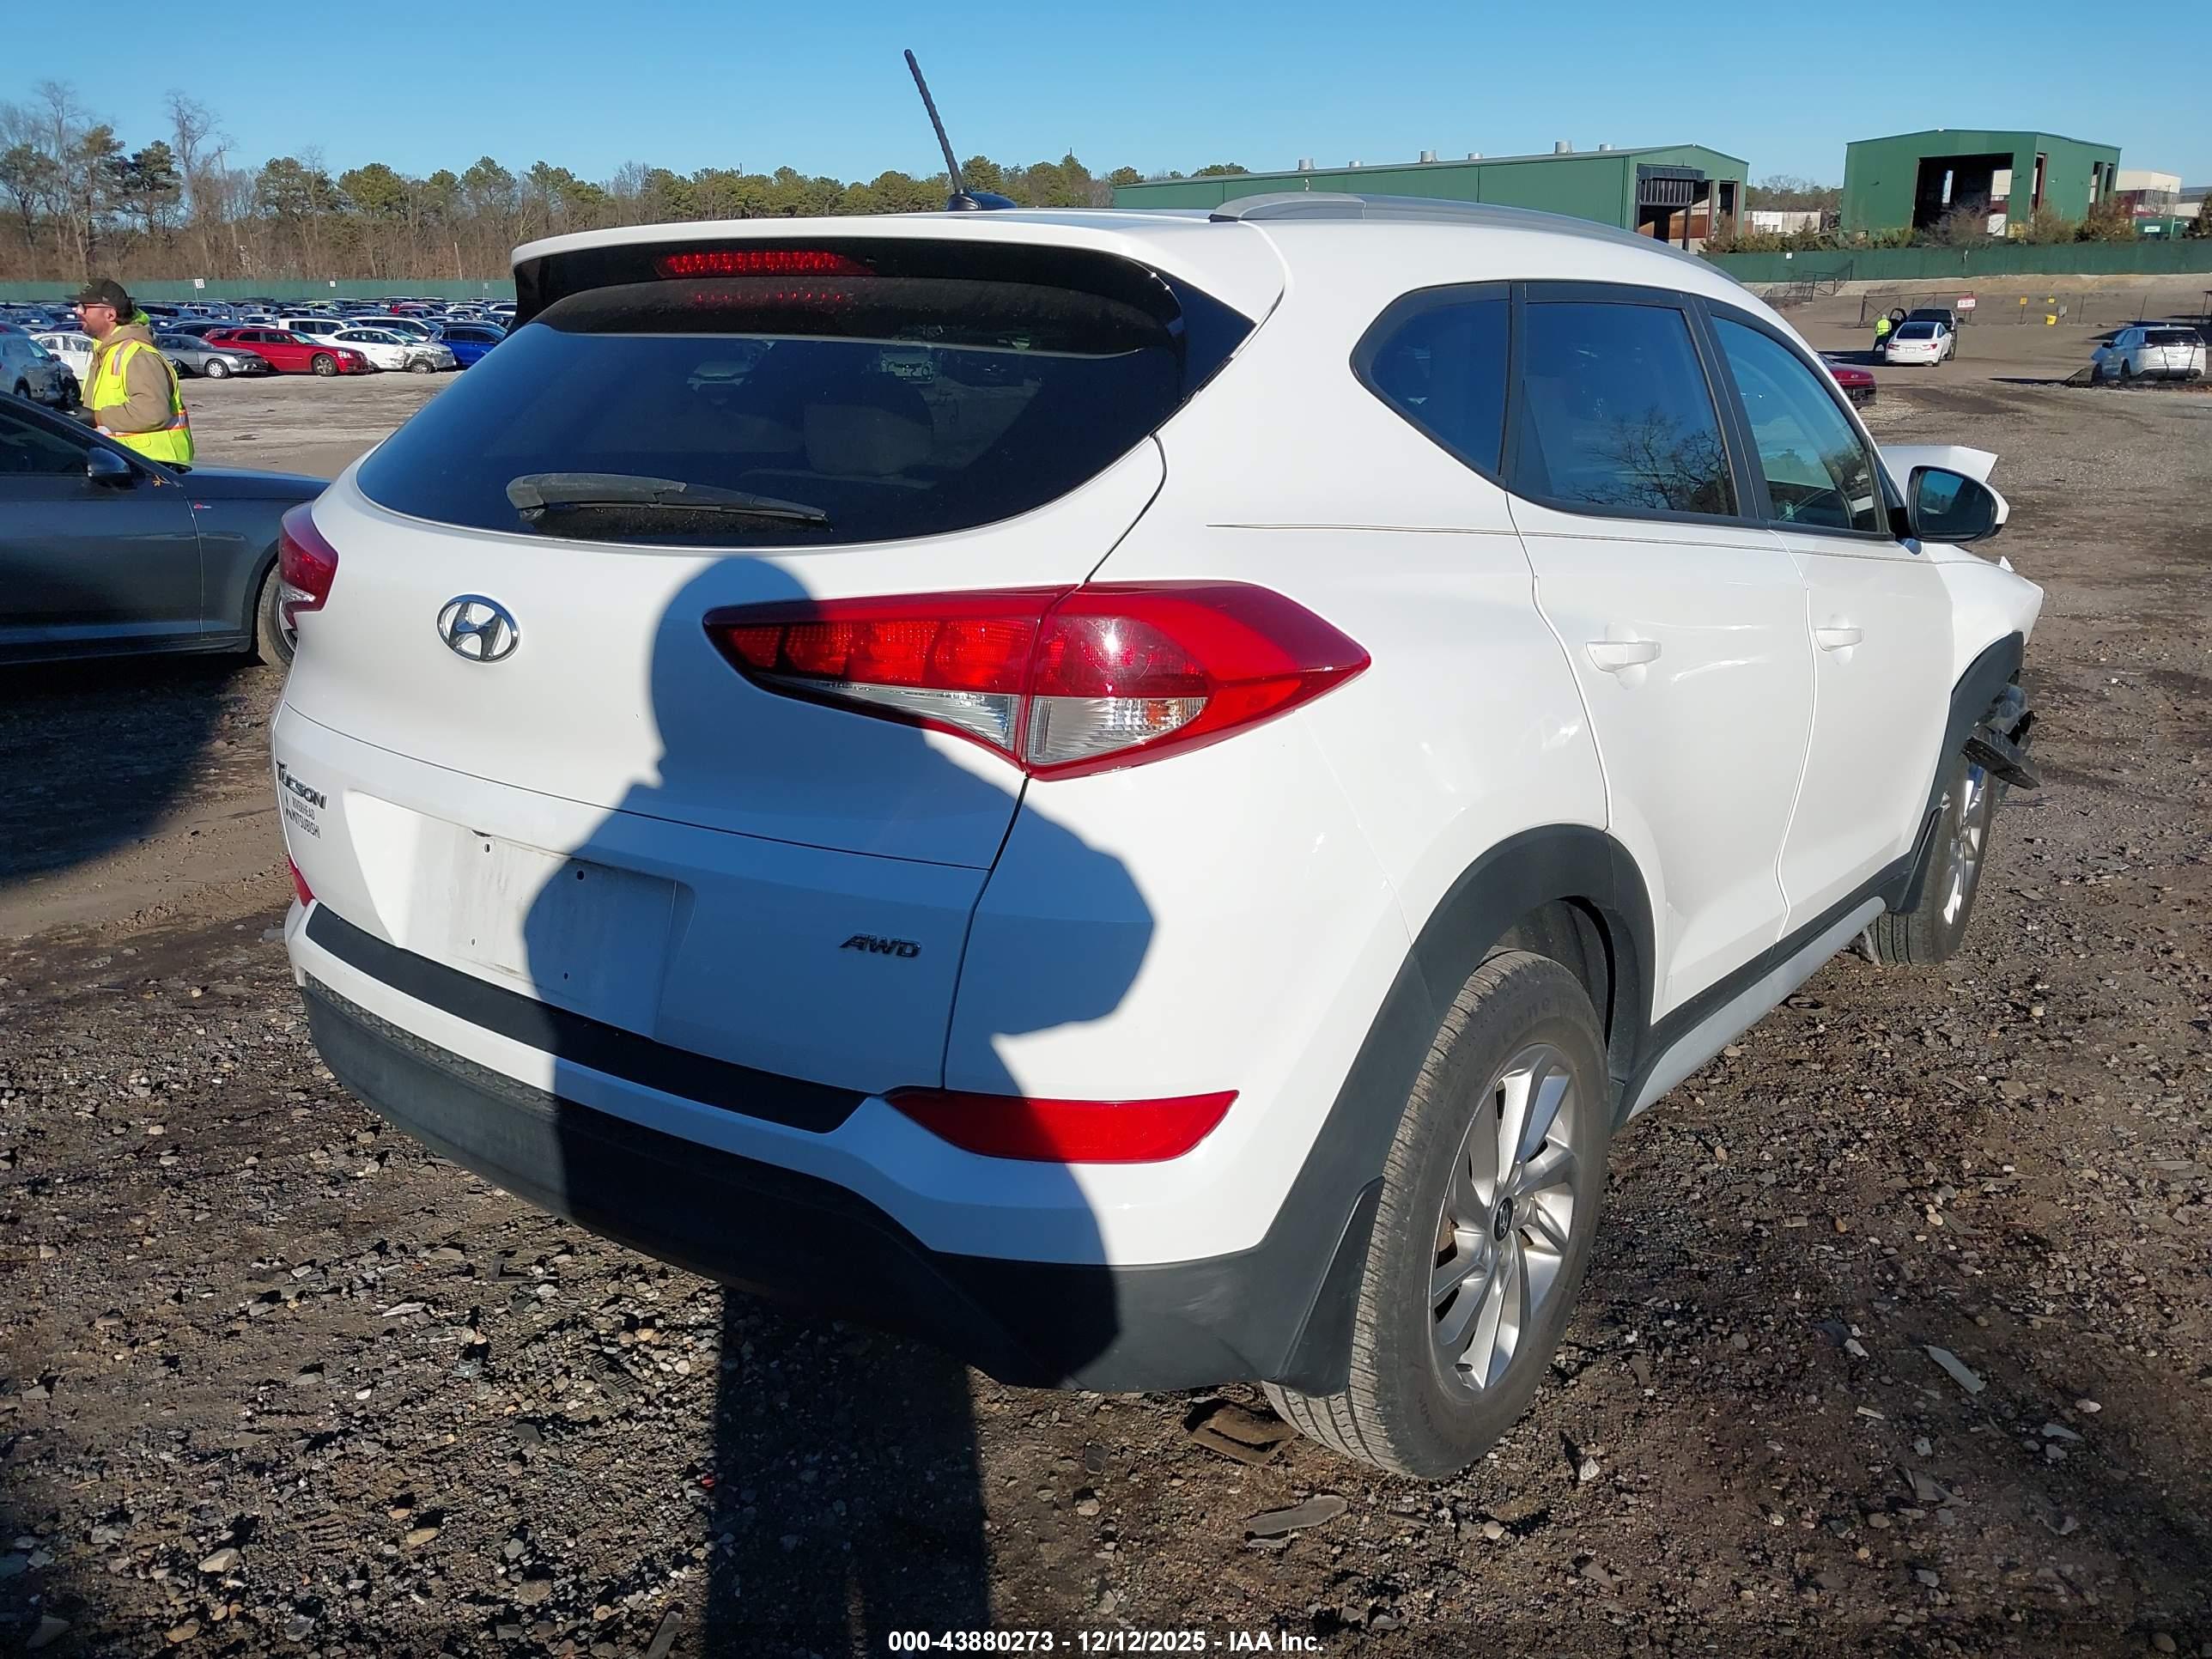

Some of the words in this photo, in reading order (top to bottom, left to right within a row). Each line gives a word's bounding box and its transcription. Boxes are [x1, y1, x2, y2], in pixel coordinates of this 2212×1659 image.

[276, 761, 328, 810] TUCSON
[285, 807, 321, 839] MITSUBISHI
[839, 933, 921, 958] AWD
